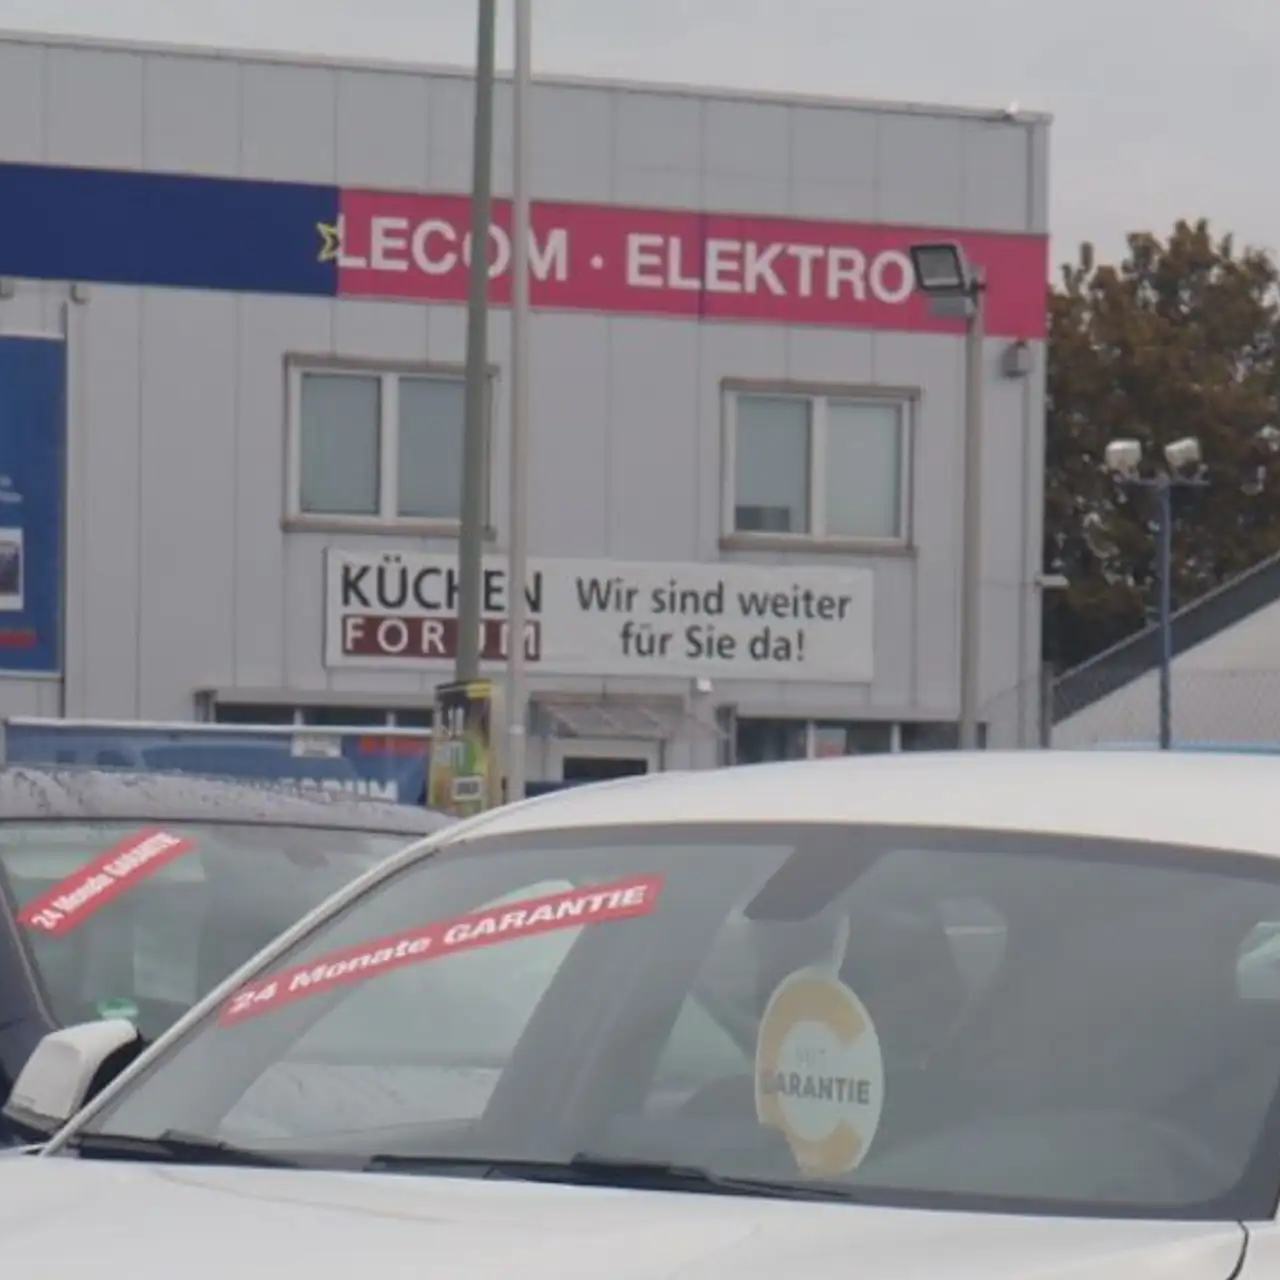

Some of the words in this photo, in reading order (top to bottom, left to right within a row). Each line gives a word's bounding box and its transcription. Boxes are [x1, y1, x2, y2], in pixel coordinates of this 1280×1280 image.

[626, 231, 916, 304] ELEKTRO
[341, 553, 543, 613] KÜCHEN
[575, 576, 639, 612] Wir
[651, 579, 725, 615] sind
[736, 583, 853, 620] weiter
[620, 620, 673, 658] für
[685, 623, 737, 660] Sie
[747, 625, 806, 662] da!
[228, 981, 279, 1015] 24
[287, 935, 430, 991] Monate
[442, 884, 649, 946] GARANTIE
[762, 1067, 872, 1106] GARANTIE
